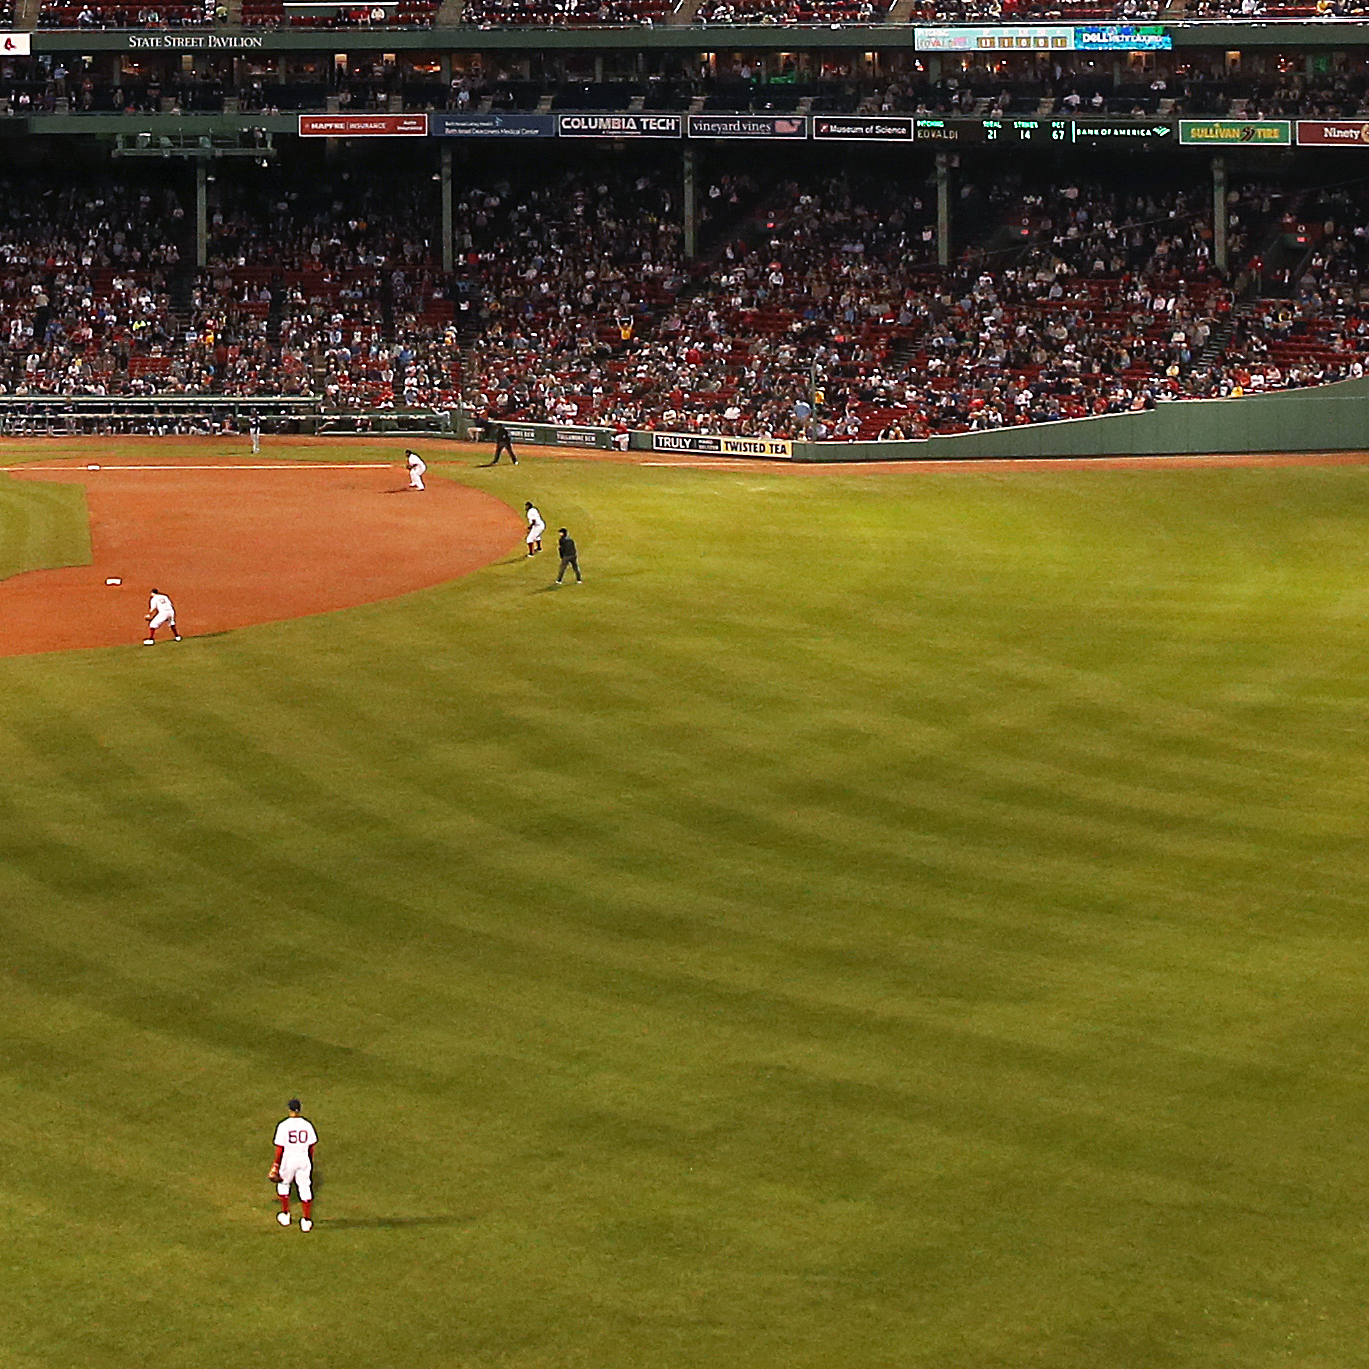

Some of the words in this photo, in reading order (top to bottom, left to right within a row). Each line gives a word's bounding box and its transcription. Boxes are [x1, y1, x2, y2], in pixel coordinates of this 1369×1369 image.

[561, 118, 637, 130] COLUMBIA
[640, 118, 676, 130] TECH
[693, 119, 741, 132] vineyard
[742, 120, 771, 131] vines
[830, 124, 863, 134] Museum
[865, 125, 873, 133] of
[875, 125, 907, 135] Science
[917, 129, 959, 139] EOVALDI
[987, 129, 997, 140] 21
[1019, 129, 1031, 140] 14
[1051, 130, 1065, 140] 67
[1113, 128, 1152, 136] AMERICA
[1191, 128, 1240, 138] SULLIVAN
[1256, 128, 1280, 138] TIRE
[1324, 127, 1360, 140] Ninety
[657, 436, 692, 449] TRULY
[723, 441, 766, 453] TWISTED
[768, 444, 788, 455] TEA
